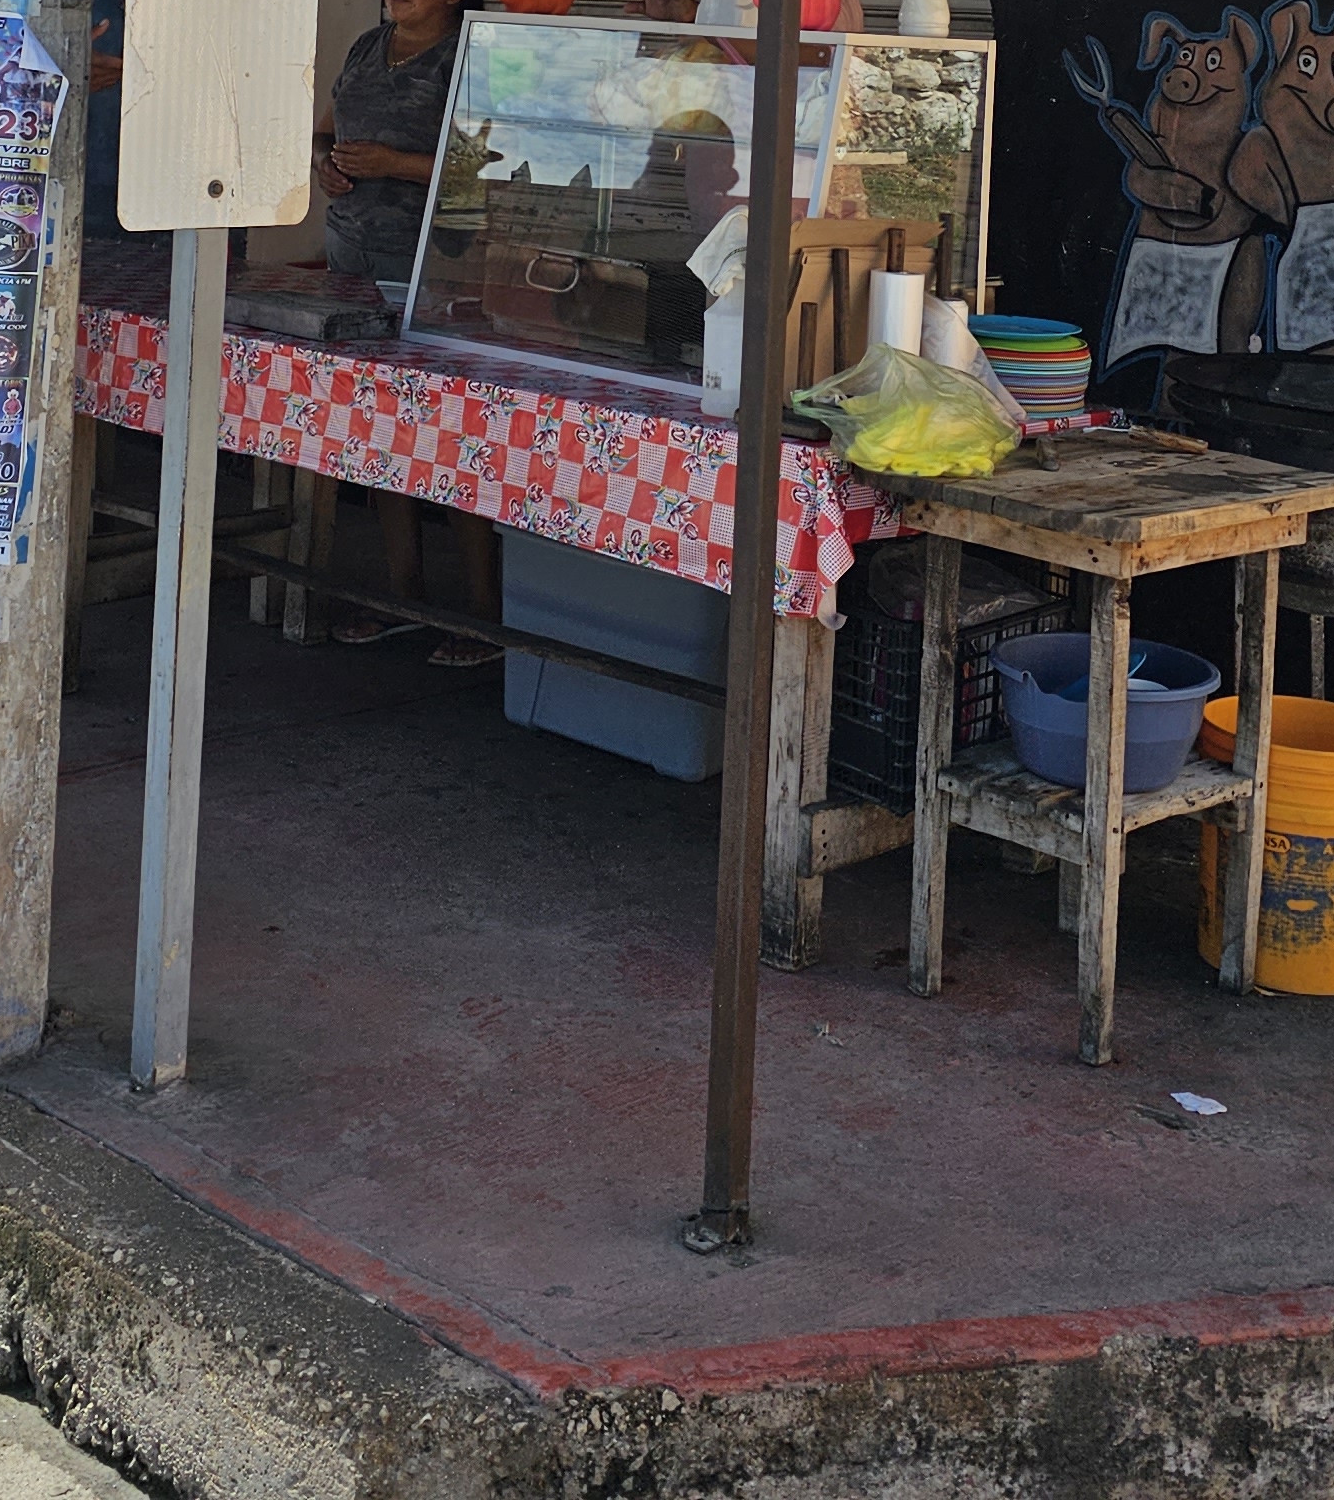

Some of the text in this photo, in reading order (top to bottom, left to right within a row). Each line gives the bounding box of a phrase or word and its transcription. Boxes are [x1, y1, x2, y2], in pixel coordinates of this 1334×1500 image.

[12, 235, 35, 248] PIKA
[7, 323, 28, 331] CON
[0, 425, 15, 434] DJ
